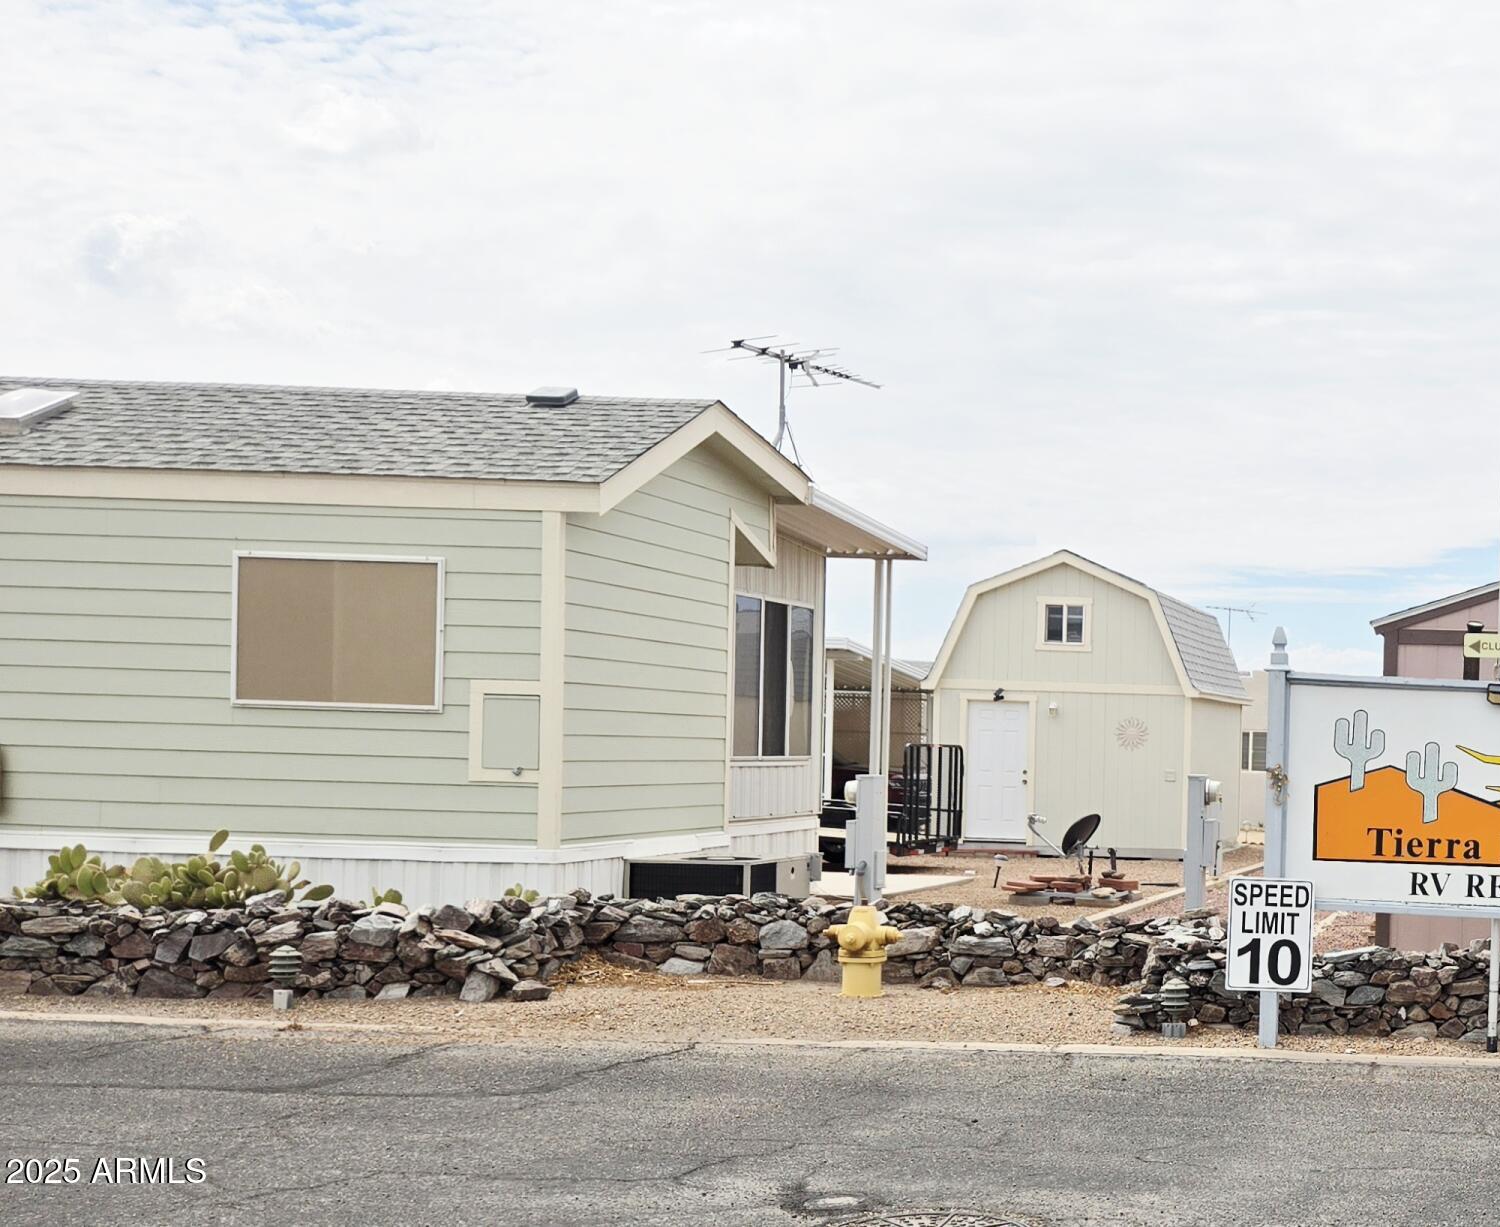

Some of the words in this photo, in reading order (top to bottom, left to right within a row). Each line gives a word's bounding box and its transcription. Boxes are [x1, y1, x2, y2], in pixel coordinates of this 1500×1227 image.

[1366, 827, 1481, 860] Tierra
[1233, 883, 1310, 908] SPEED
[1409, 871, 1451, 897] RV
[1241, 911, 1300, 935] LIMIT
[1237, 937, 1302, 986] 10
